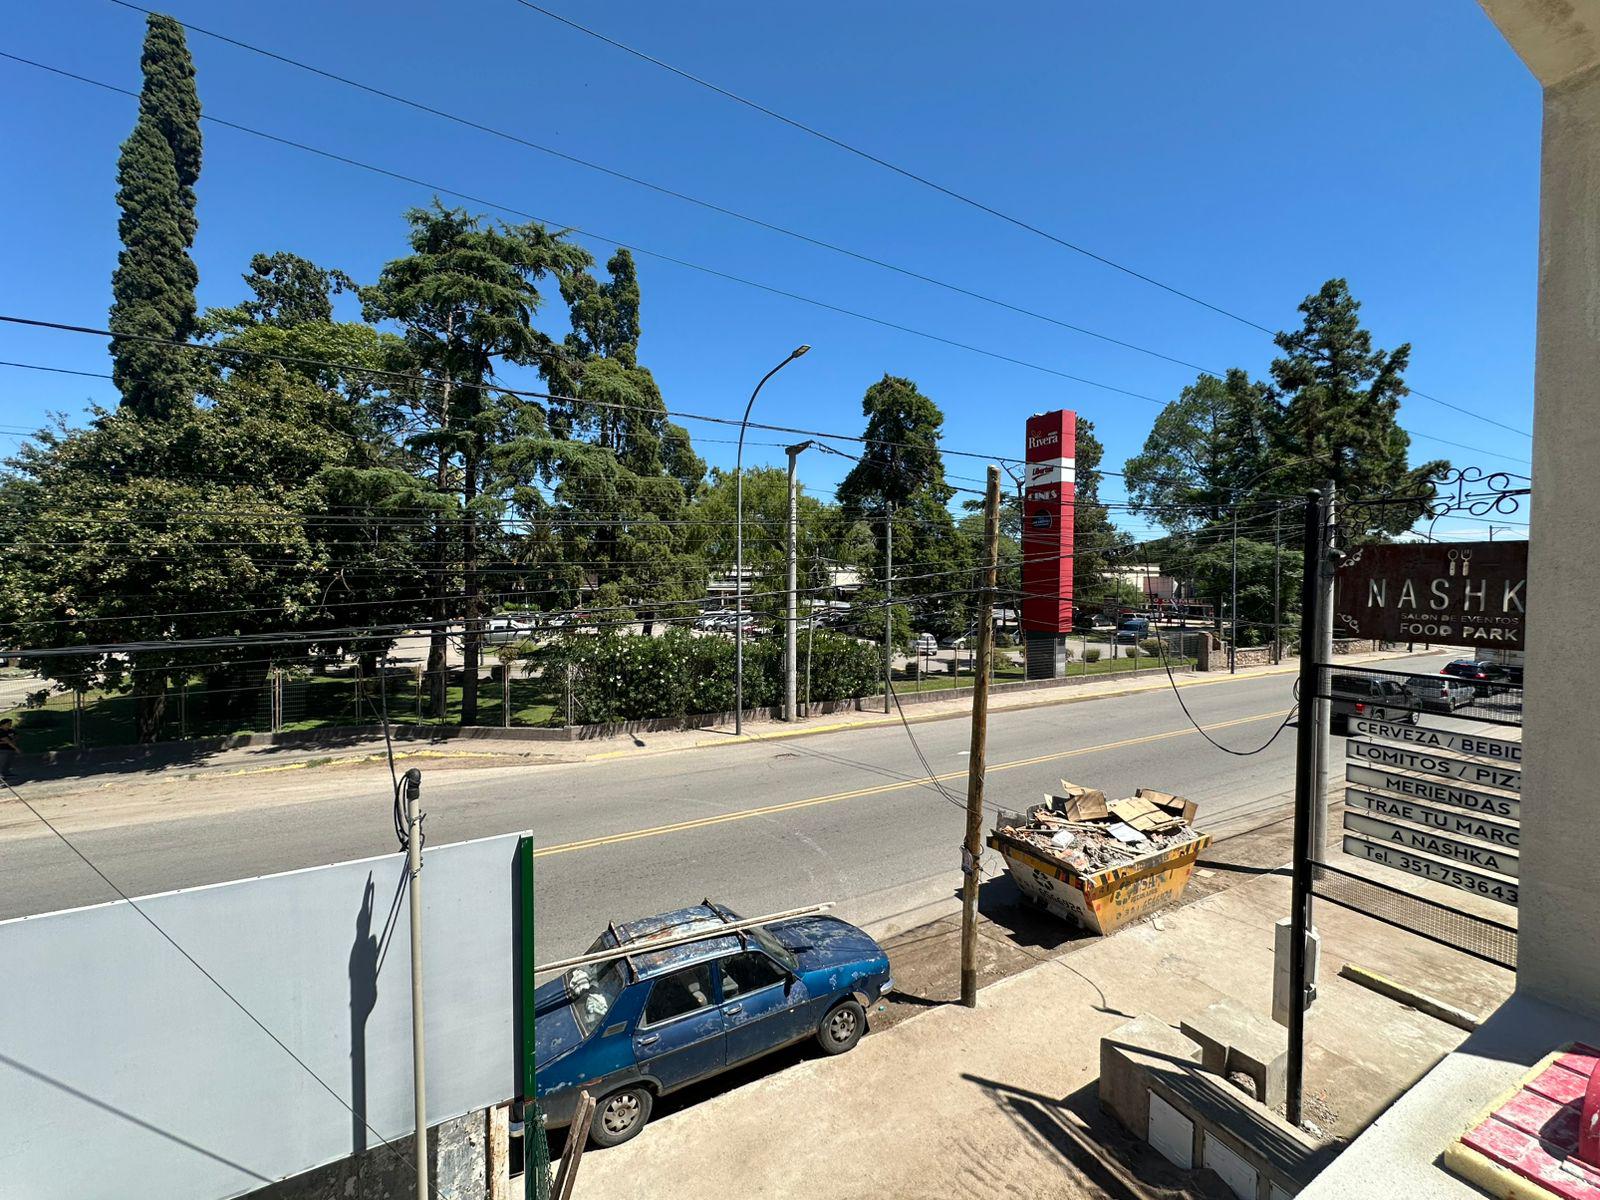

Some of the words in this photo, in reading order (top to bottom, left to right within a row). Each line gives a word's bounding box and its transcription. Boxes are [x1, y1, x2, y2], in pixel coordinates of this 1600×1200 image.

[1028, 435, 1059, 449] Rivera
[1400, 622, 1453, 637] FOOD
[1462, 626, 1519, 642] PARK
[1461, 615, 1519, 625] EVENTOS
[1357, 721, 1440, 746] CERVEZA
[1355, 745, 1450, 774] LOMITOS
[1476, 769, 1521, 790] PIZ
[1386, 777, 1511, 815] MERIENDAS
[1364, 797, 1413, 818] TRAE
[1421, 811, 1448, 827] TU
[1364, 845, 1392, 864] Tel.
[1391, 830, 1404, 843] A
[1411, 834, 1499, 870] NASHKA
